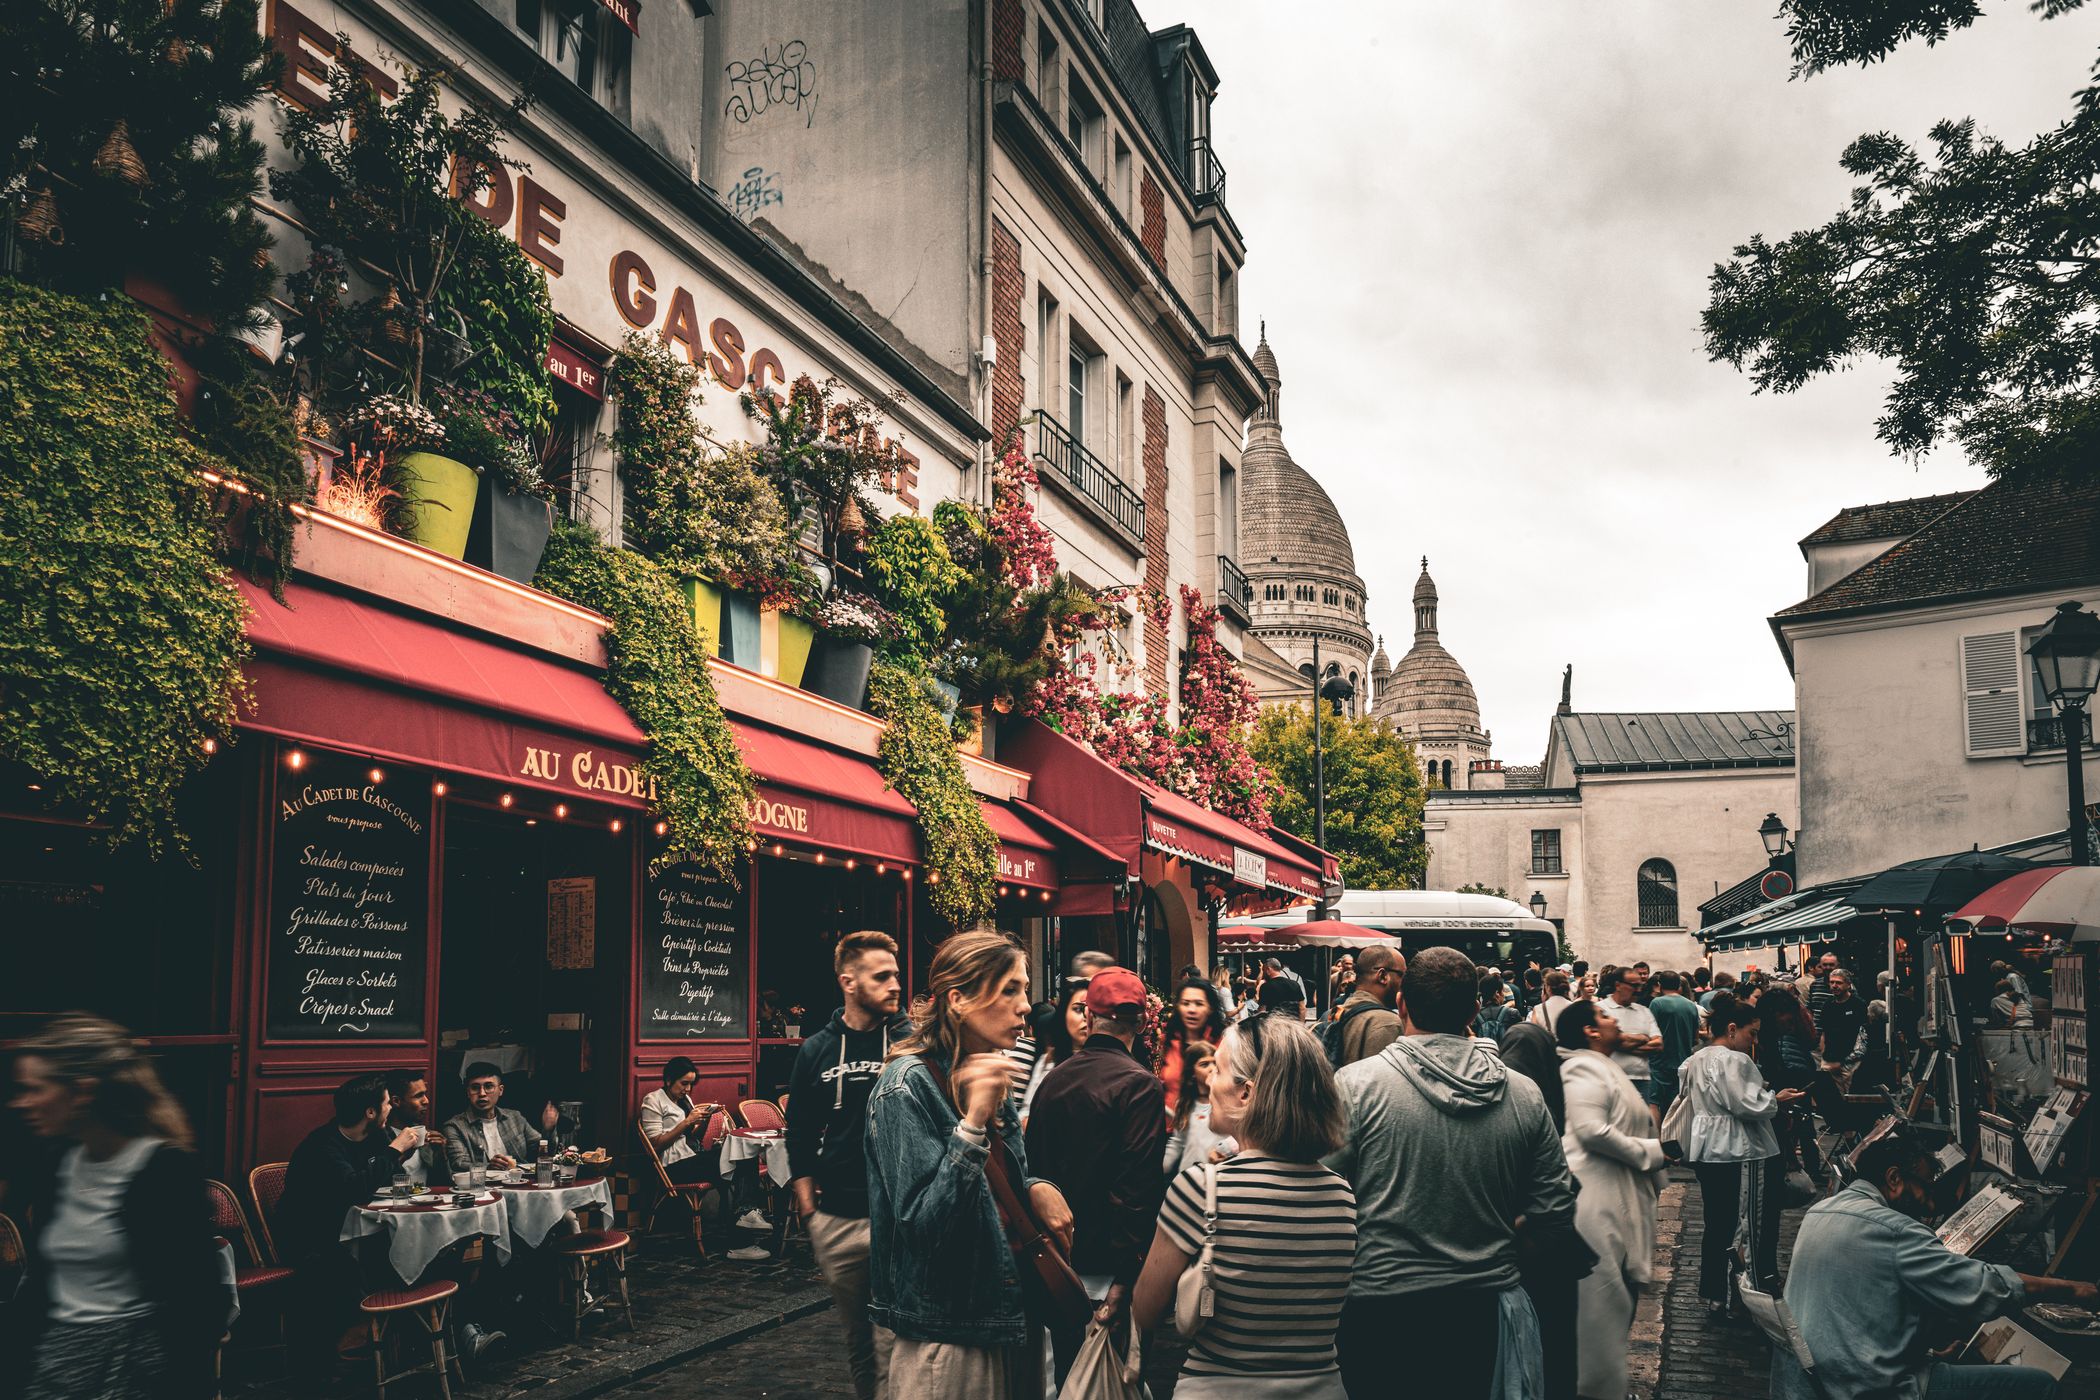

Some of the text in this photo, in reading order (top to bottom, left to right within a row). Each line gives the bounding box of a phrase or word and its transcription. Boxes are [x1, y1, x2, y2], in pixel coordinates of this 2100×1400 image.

[550, 358, 595, 388] au 1er
[521, 747, 561, 780] AU
[281, 784, 422, 835] AU CADET DE GASCOGNE
[326, 814, 384, 832] vous propose
[1152, 820, 1176, 838] BUVETTE
[300, 844, 404, 880] Salades composées
[1014, 863, 1022, 877] au
[1024, 859, 1035, 879] 1er
[303, 877, 395, 908] Plats du jour
[704, 895, 733, 910] Chocolat
[286, 906, 408, 935] Grillades & Poissons
[703, 921, 735, 935] pression
[1442, 920, 1467, 928] 100%
[362, 946, 402, 960] maison
[662, 934, 697, 958] Apéritifs
[704, 939, 732, 954] Cocktails
[662, 956, 730, 981] Vins de Propriétés
[302, 968, 397, 994] Glaces & Sorbets
[679, 980, 714, 1006] Digestifs
[299, 996, 394, 1025] Crêpes & Snack
[652, 1008, 732, 1027] Salle climatisée à l'étage
[821, 1061, 884, 1082] SCALPE
